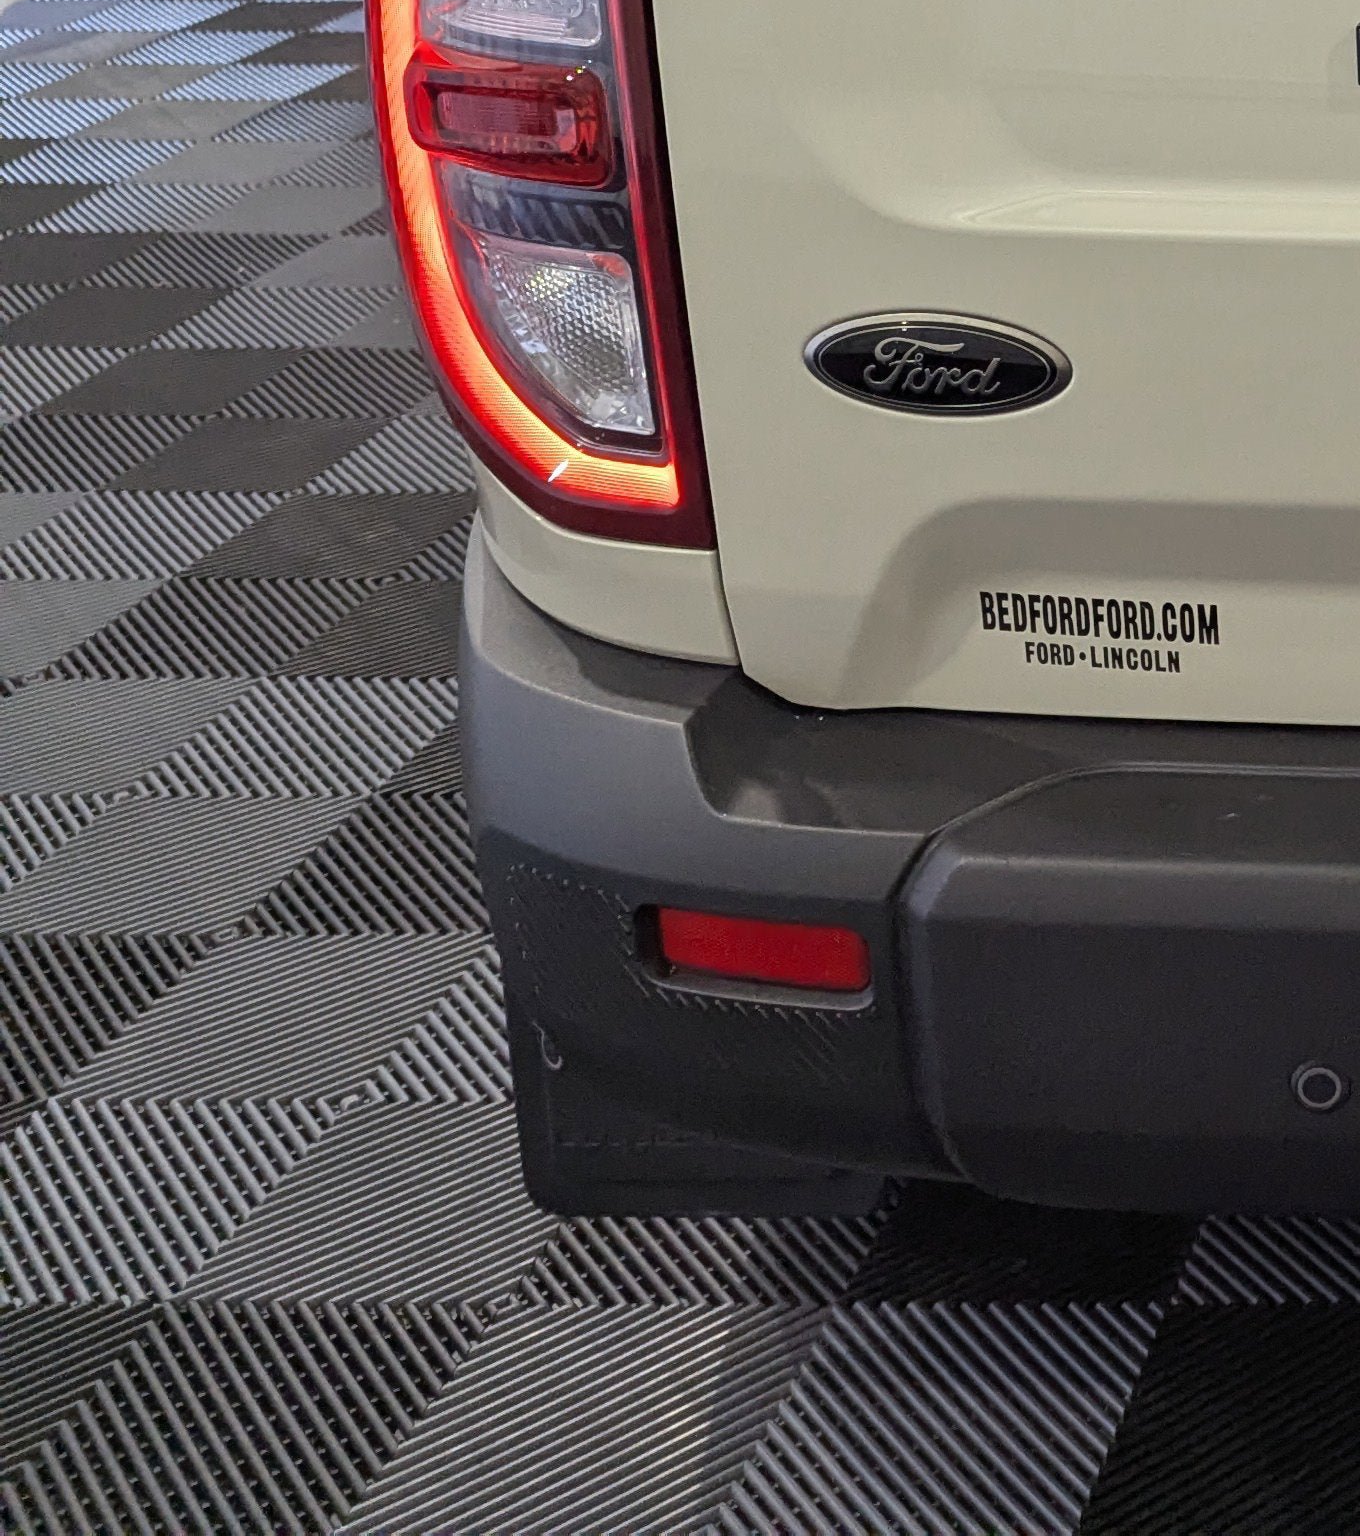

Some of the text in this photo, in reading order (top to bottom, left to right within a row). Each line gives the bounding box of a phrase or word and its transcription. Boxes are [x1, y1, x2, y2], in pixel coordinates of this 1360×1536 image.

[863, 336, 1001, 396] Ford
[979, 590, 1220, 645] BEDFORDFORD.COM
[1024, 640, 1181, 673] FORD LINCOLN
